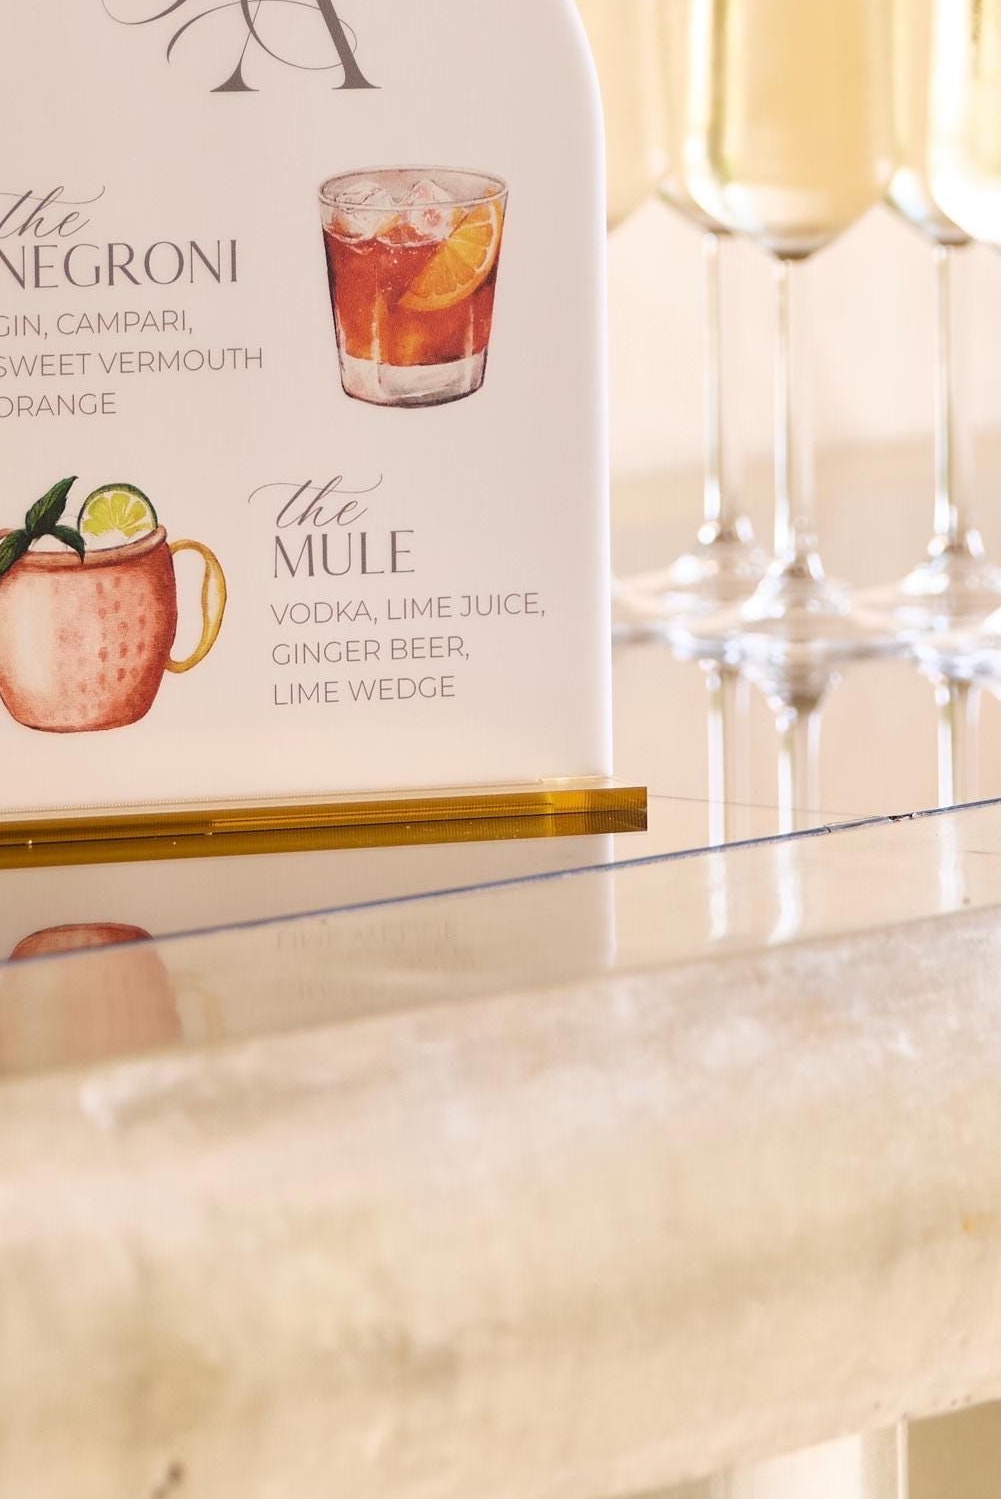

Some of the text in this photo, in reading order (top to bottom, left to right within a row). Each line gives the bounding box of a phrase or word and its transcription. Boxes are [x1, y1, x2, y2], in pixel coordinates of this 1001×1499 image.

[56, 309, 194, 336] CAMPARI,
[97, 347, 264, 375] VERMOUTH
[247, 472, 384, 529] the
[273, 529, 416, 579] MULE
[269, 591, 546, 626] VODKA, LIME JUICE,
[271, 635, 470, 666] GINGER BEER,
[273, 675, 457, 706] LIME WEDGE
